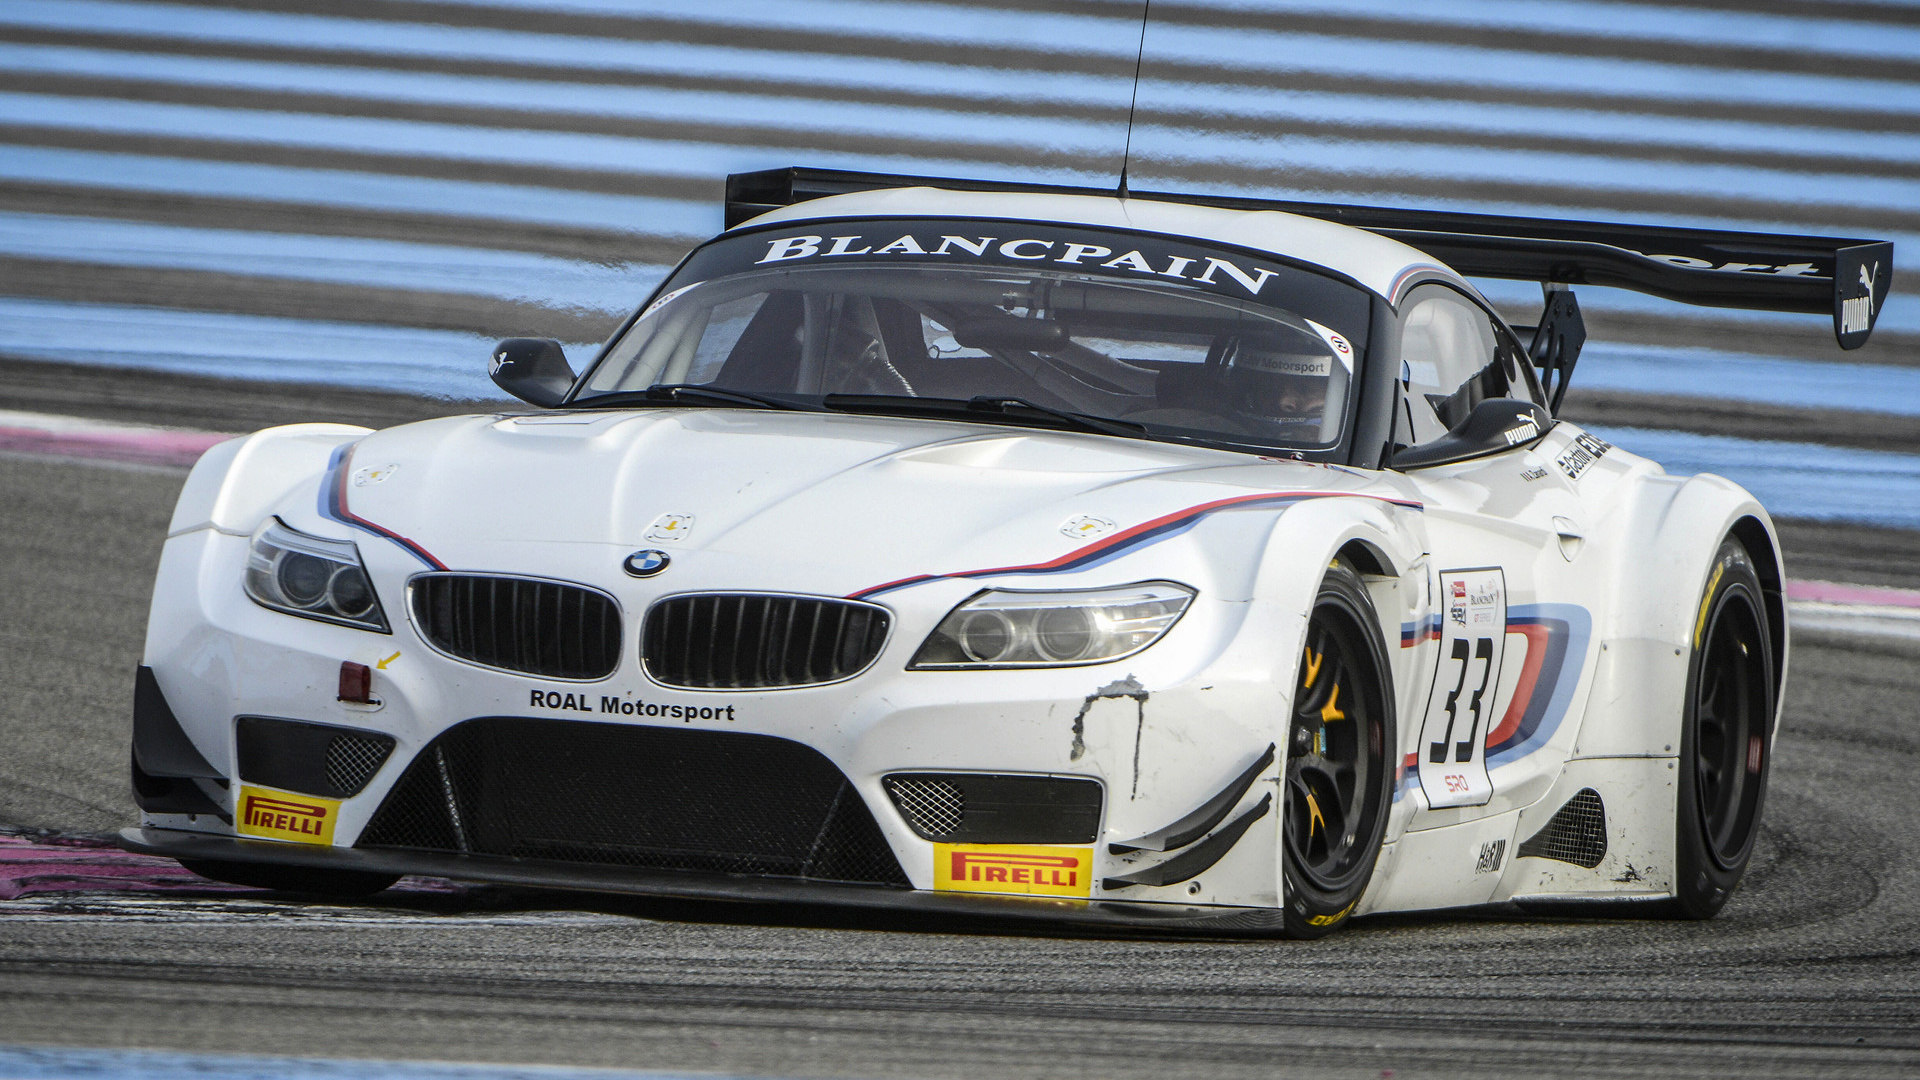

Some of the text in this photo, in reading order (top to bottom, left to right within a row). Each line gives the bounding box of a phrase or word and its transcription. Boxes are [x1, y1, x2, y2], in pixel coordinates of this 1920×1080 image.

[754, 234, 1279, 295] BLANCPAIN
[1841, 296, 1870, 334] PUMA
[1503, 422, 1537, 446] PUMA
[530, 689, 735, 722] ROAL Motorsport
[1429, 637, 1493, 763] 33
[1444, 774, 1469, 792] SRO
[244, 795, 327, 836] PIRELLI
[951, 851, 1079, 887] PIRELLI
